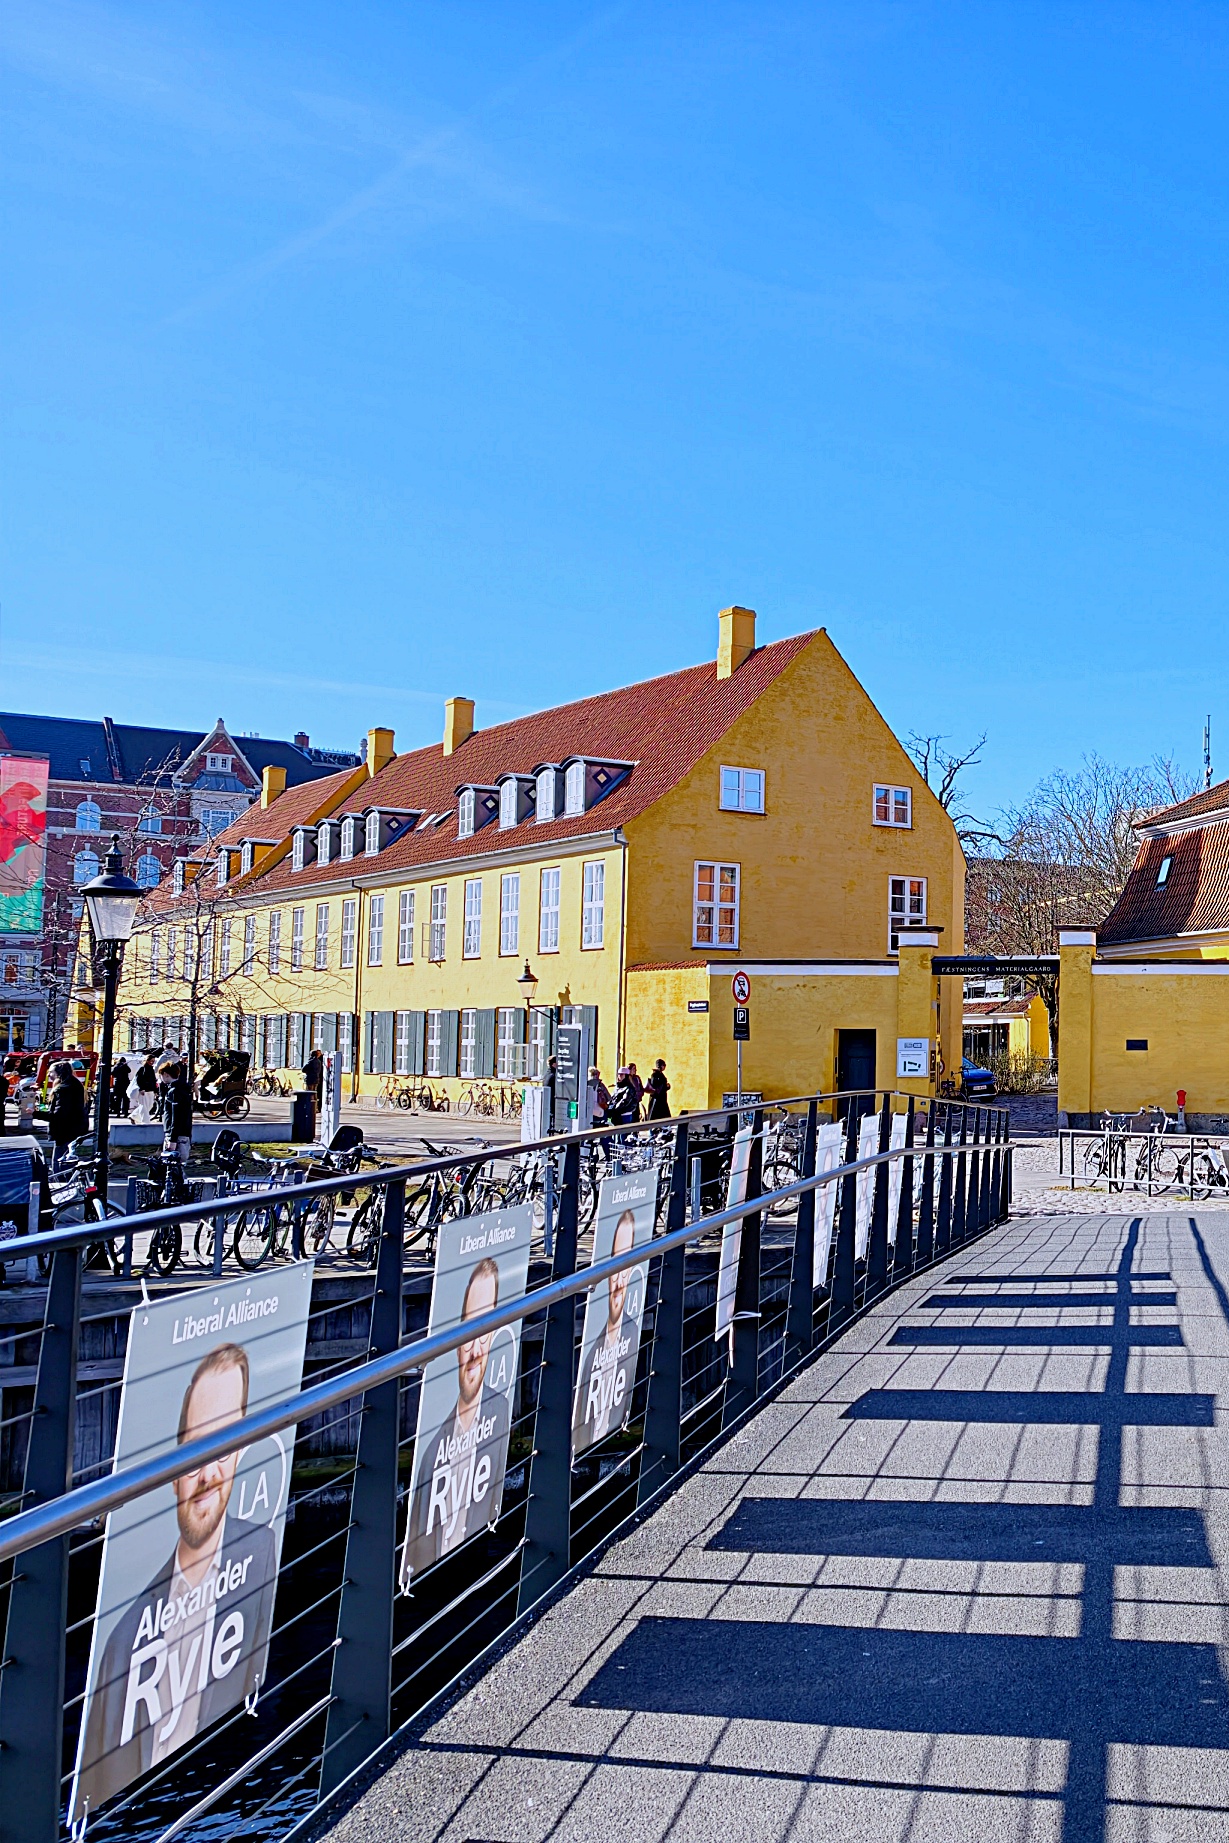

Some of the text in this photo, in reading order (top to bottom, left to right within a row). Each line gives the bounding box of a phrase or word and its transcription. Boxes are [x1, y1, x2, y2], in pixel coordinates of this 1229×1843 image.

[739, 1011, 744, 1021] P
[611, 1186, 647, 1205] Liberal Alliance
[459, 1225, 516, 1255] Liberal Alliance
[172, 1295, 279, 1345] Liberal Alliance
[626, 1296, 639, 1316] LA
[488, 1355, 507, 1389] LA
[591, 1336, 631, 1372] Alexander
[585, 1365, 626, 1428] Ryle
[434, 1415, 497, 1469] Alexander
[236, 1482, 270, 1521] LA
[426, 1448, 492, 1539] Ryle
[132, 1555, 253, 1651] Alexander
[119, 1607, 244, 1747] Ryle
